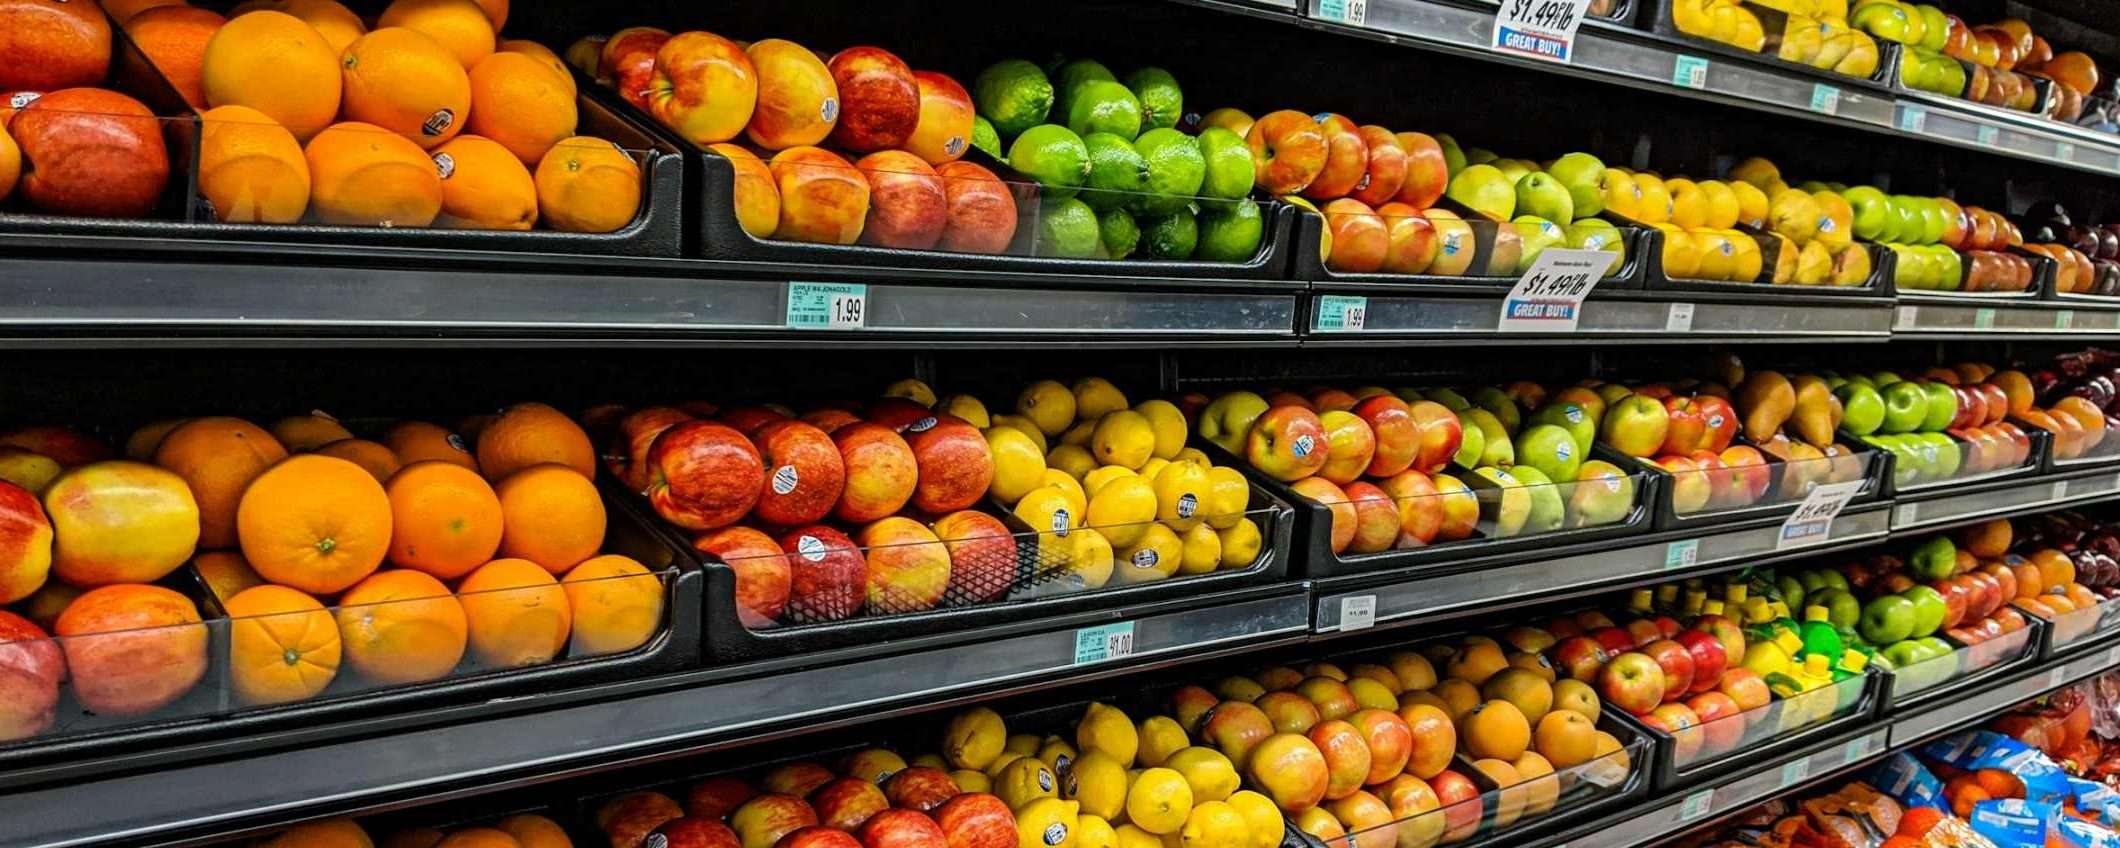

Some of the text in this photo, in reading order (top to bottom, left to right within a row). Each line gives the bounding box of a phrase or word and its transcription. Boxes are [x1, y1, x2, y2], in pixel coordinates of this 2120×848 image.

[1505, 32, 1538, 51] GREAT
[1538, 39, 1562, 56] BUY!
[1522, 272, 1573, 296] $1.49
[836, 298, 861, 322] 1.99
[1347, 308, 1363, 327] 1.99
[1514, 303, 1569, 318] GREAT BUY!
